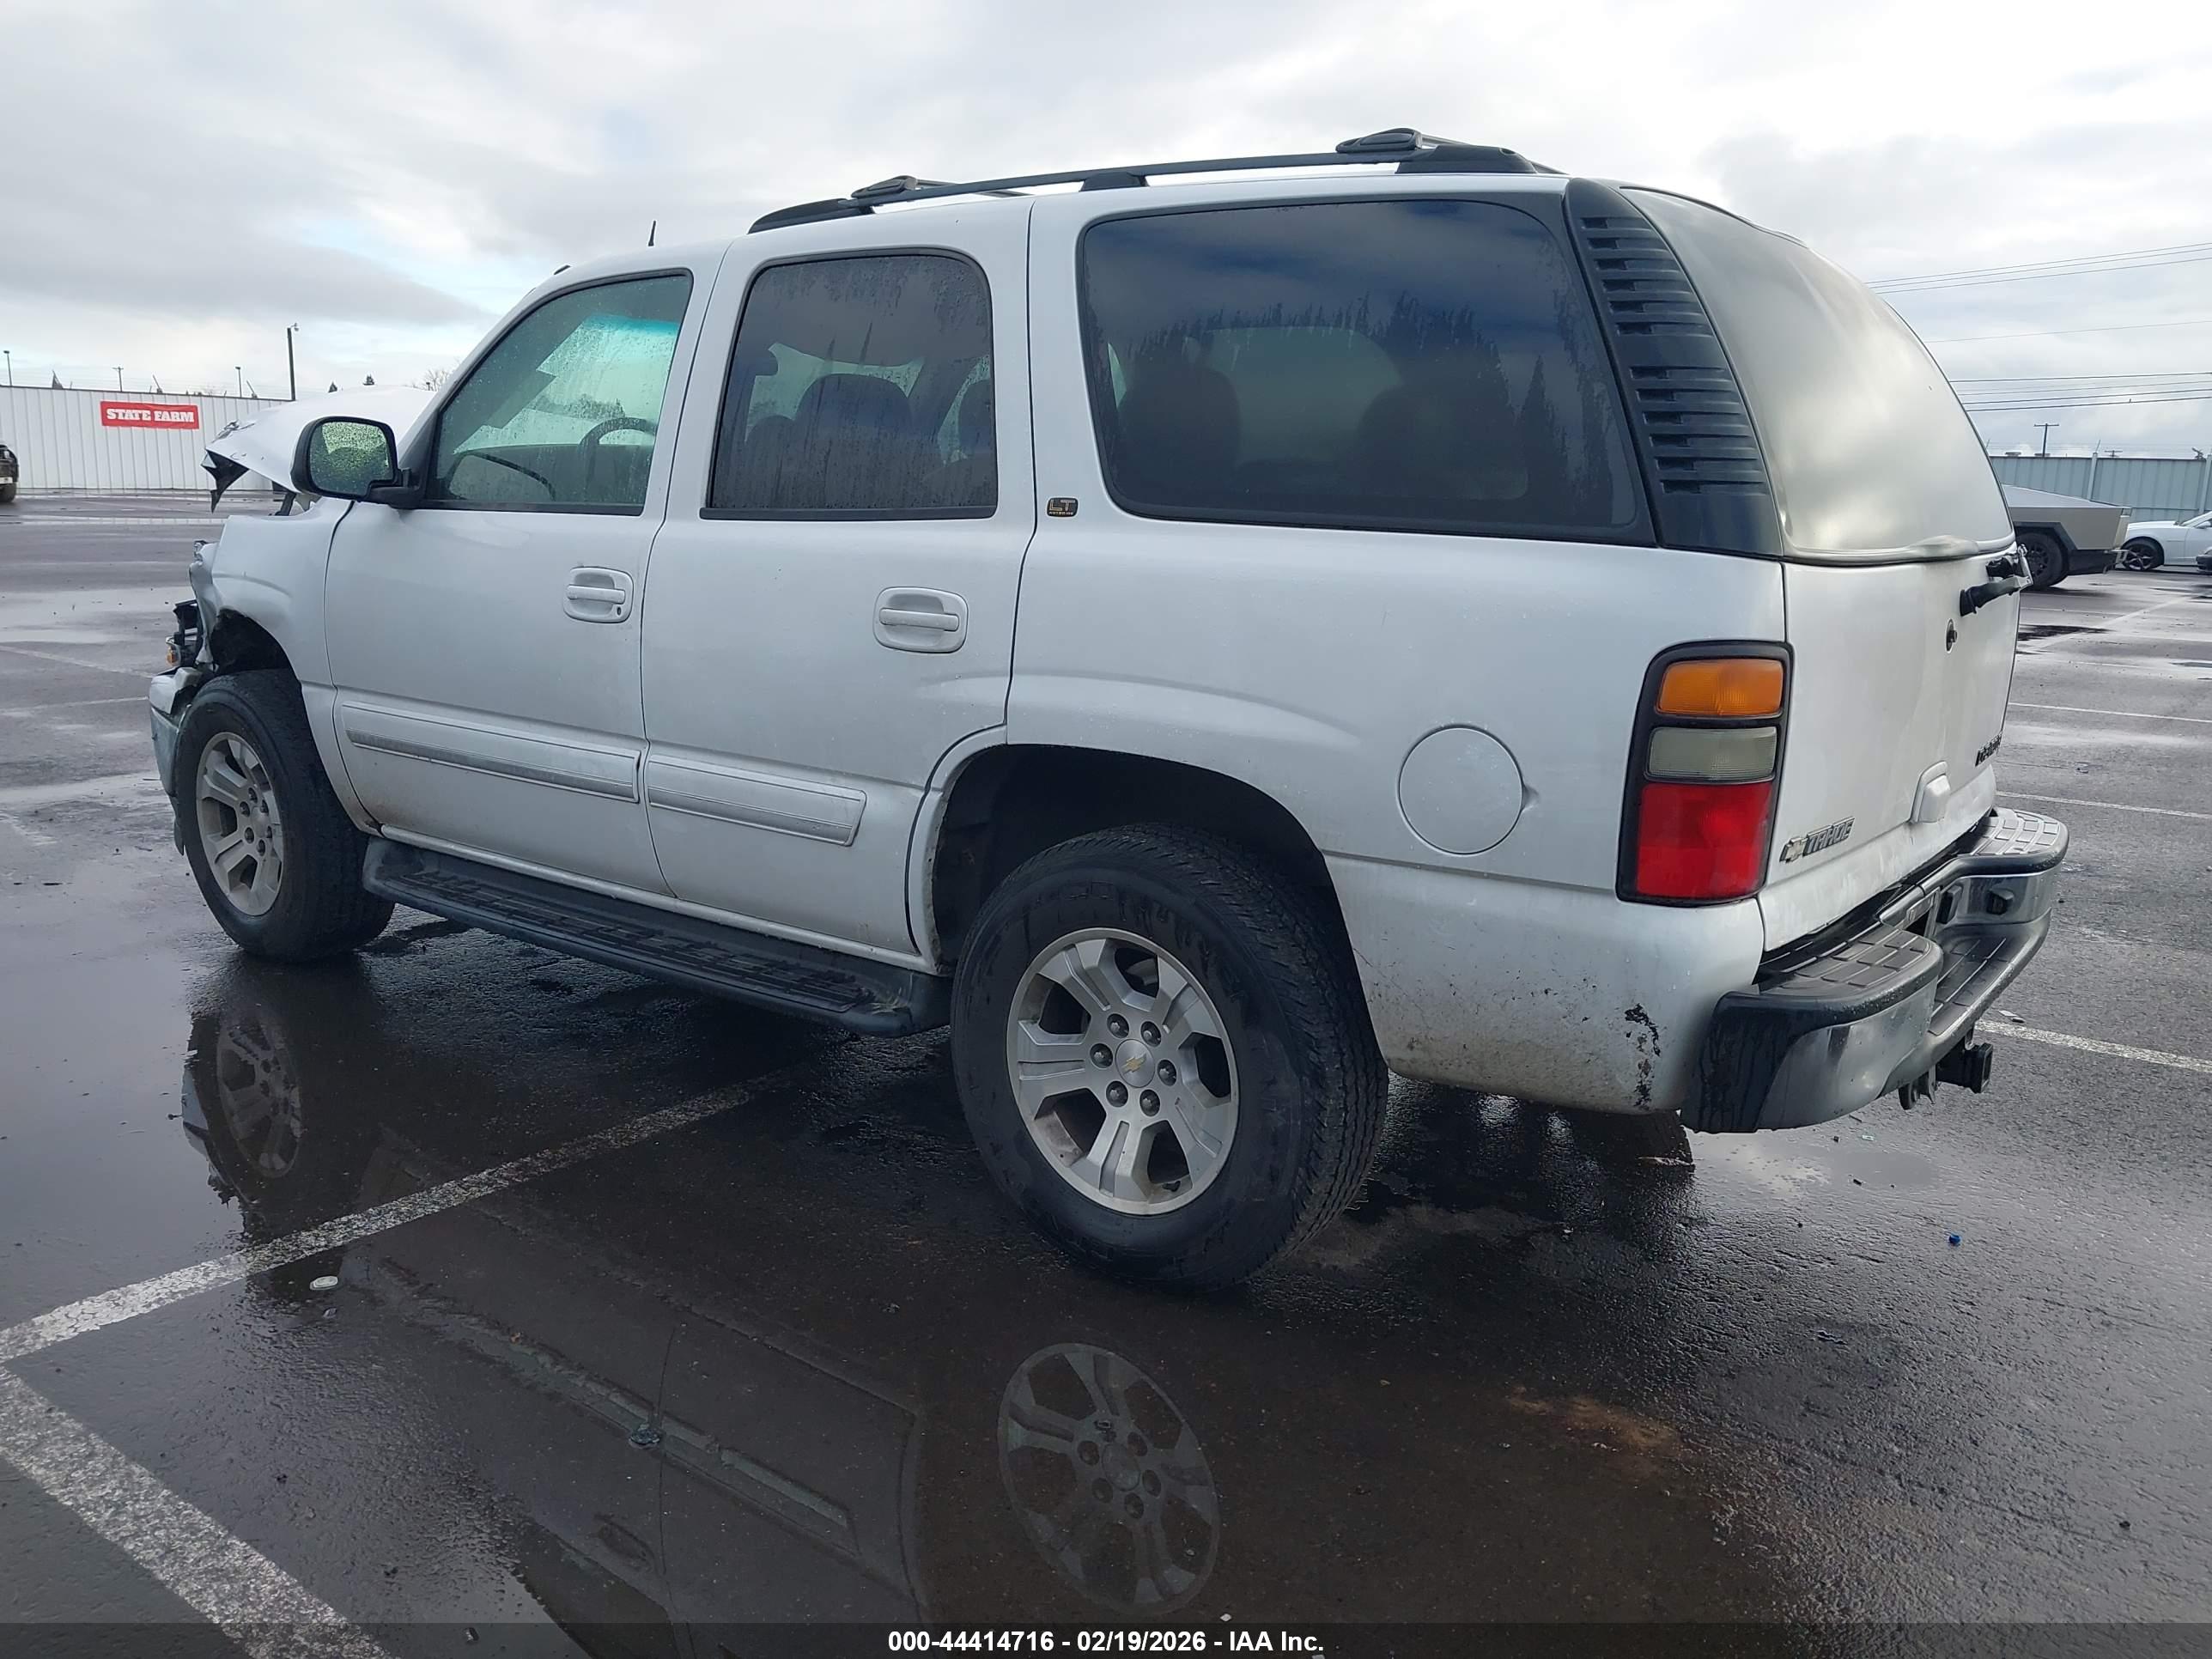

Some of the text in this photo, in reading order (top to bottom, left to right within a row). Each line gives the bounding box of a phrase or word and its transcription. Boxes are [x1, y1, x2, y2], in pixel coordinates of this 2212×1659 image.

[106, 408, 195, 422] STATE FARM
[1048, 499, 1076, 512] LT
[1802, 816, 1855, 857] TAHOE
